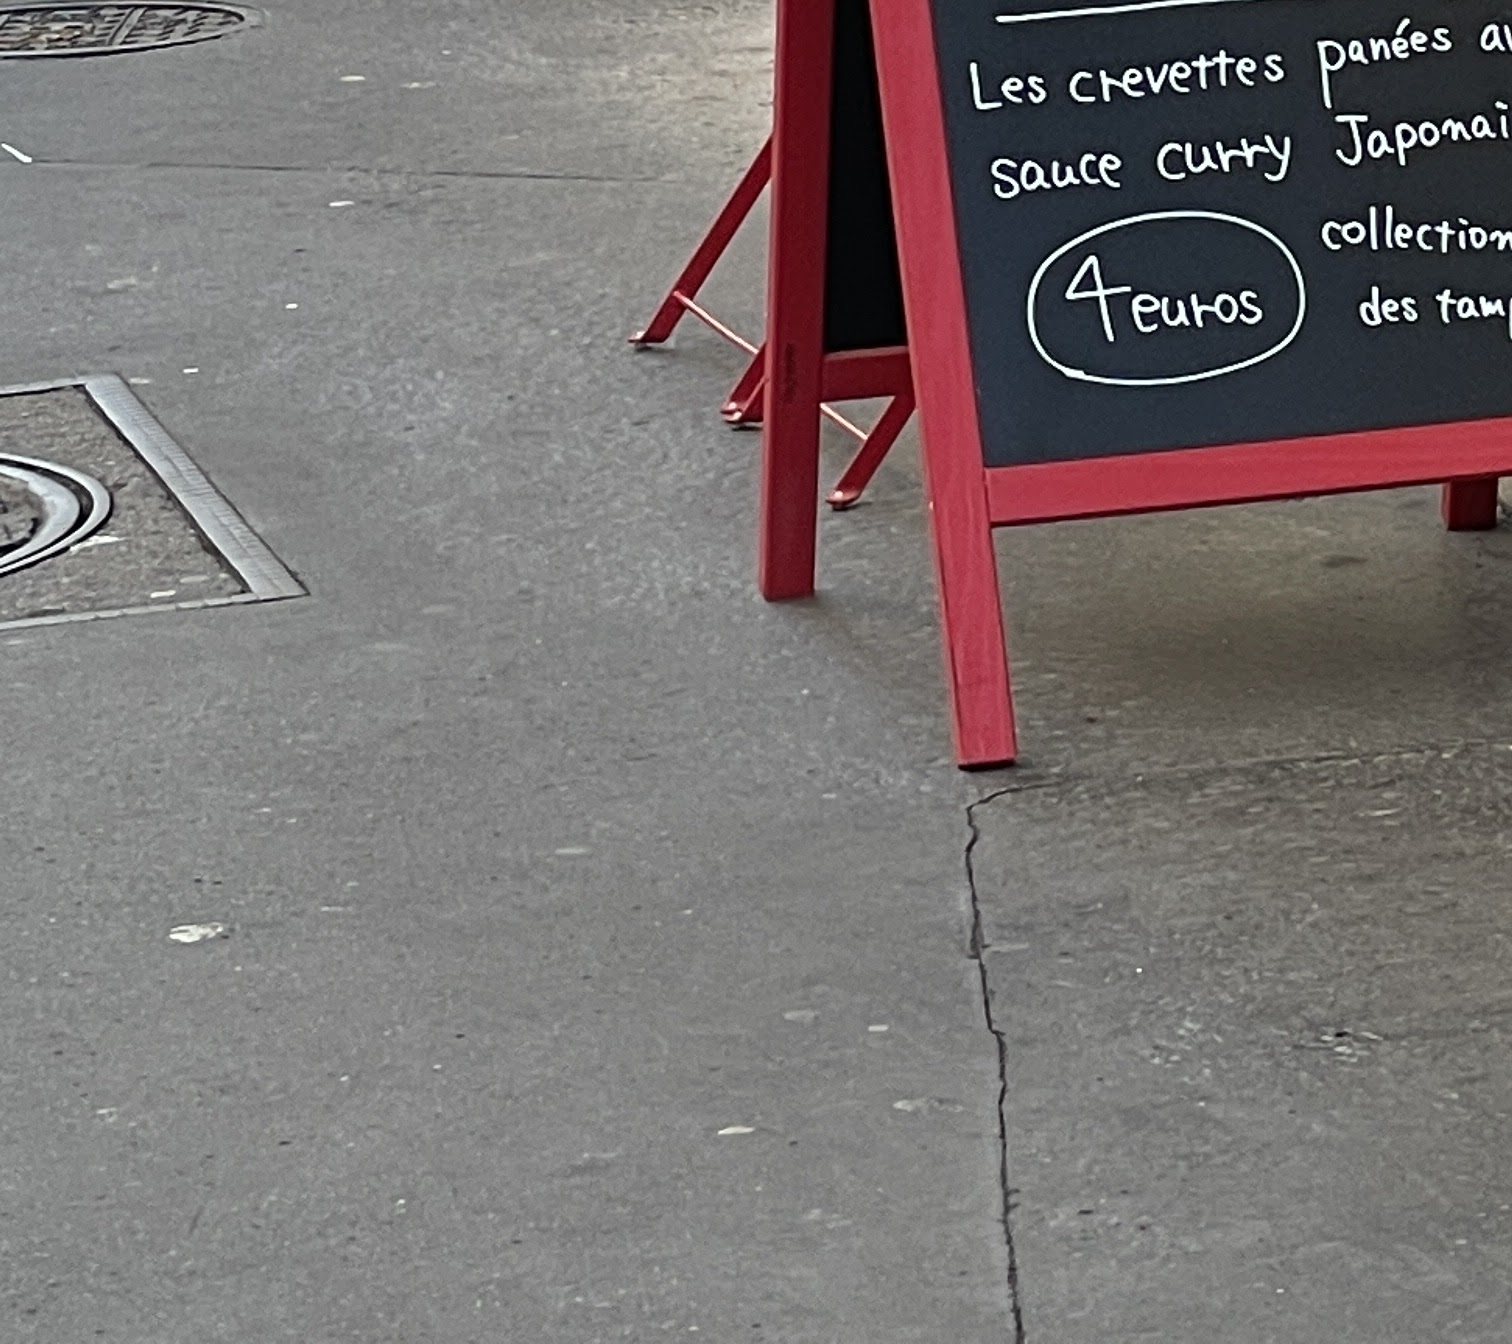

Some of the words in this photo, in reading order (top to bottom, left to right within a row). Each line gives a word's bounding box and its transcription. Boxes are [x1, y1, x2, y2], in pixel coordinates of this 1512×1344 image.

[969, 61, 1047, 111] Les
[1068, 49, 1286, 104] crevettes
[1316, 17, 1454, 109] panées
[991, 150, 1123, 200] sauce
[1156, 131, 1293, 184] curry
[1359, 287, 1418, 329] des
